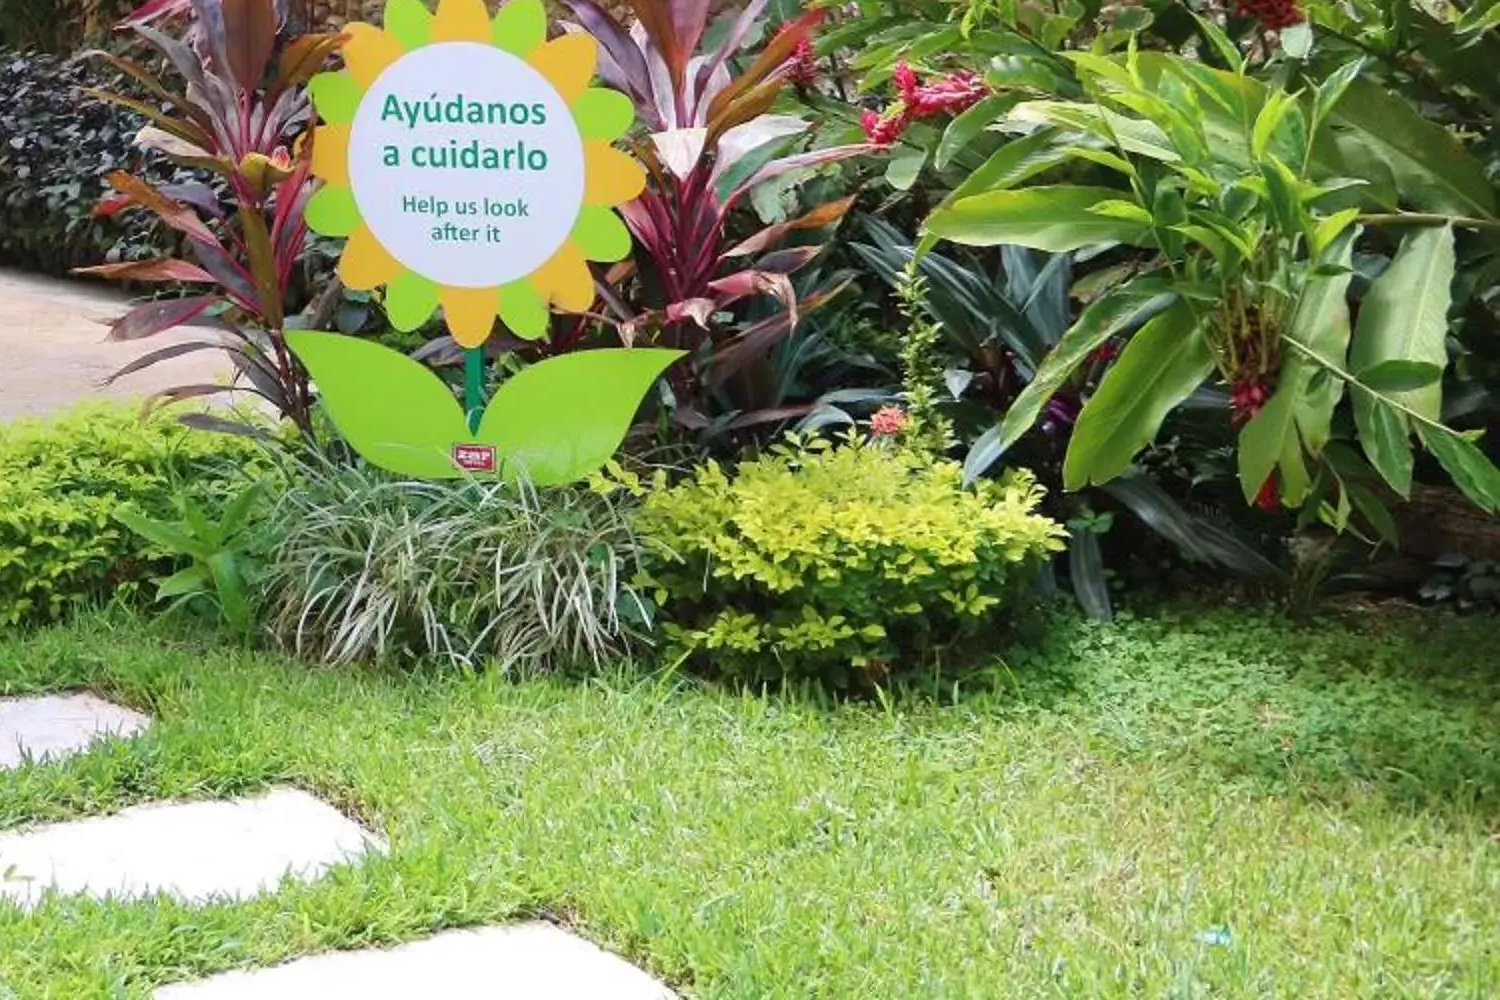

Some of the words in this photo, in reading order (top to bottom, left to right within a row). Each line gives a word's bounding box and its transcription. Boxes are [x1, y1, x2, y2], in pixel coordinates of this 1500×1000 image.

[380, 92, 547, 130] Ayúdanos
[382, 144, 401, 168] a
[410, 139, 549, 172] cuidarlo
[402, 195, 449, 219] Help
[455, 201, 478, 216] us
[483, 197, 529, 217] look
[431, 221, 481, 242] after
[486, 223, 501, 243] it
